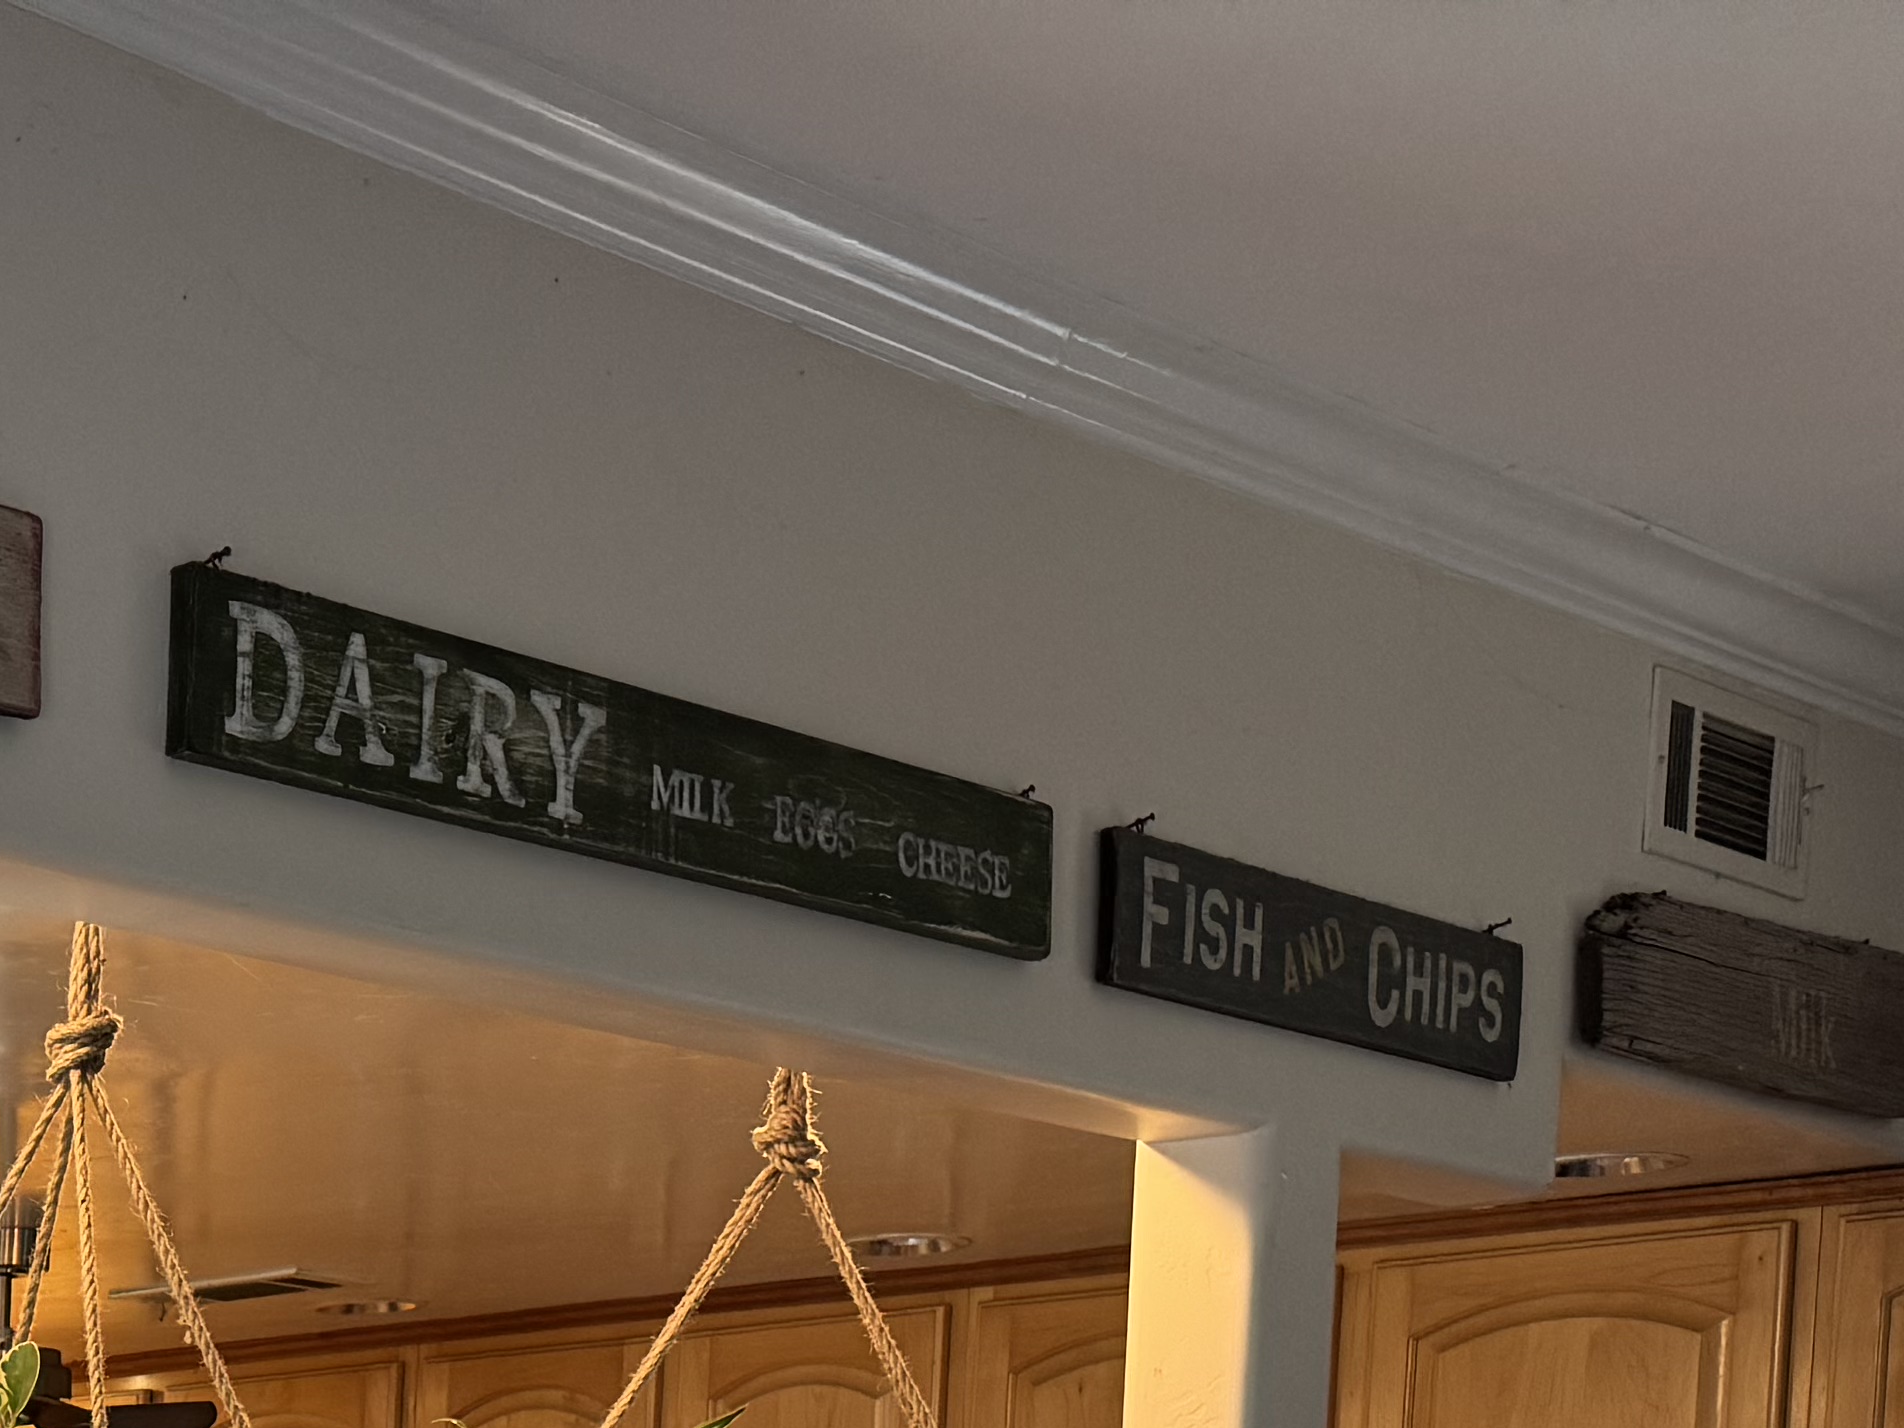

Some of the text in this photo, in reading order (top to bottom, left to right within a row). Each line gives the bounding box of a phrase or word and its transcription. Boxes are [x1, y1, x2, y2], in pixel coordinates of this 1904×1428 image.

[224, 601, 1012, 899] DAIRY MILK EGGS CHEESE
[1140, 856, 1504, 1043] FISH AND CHIPS
